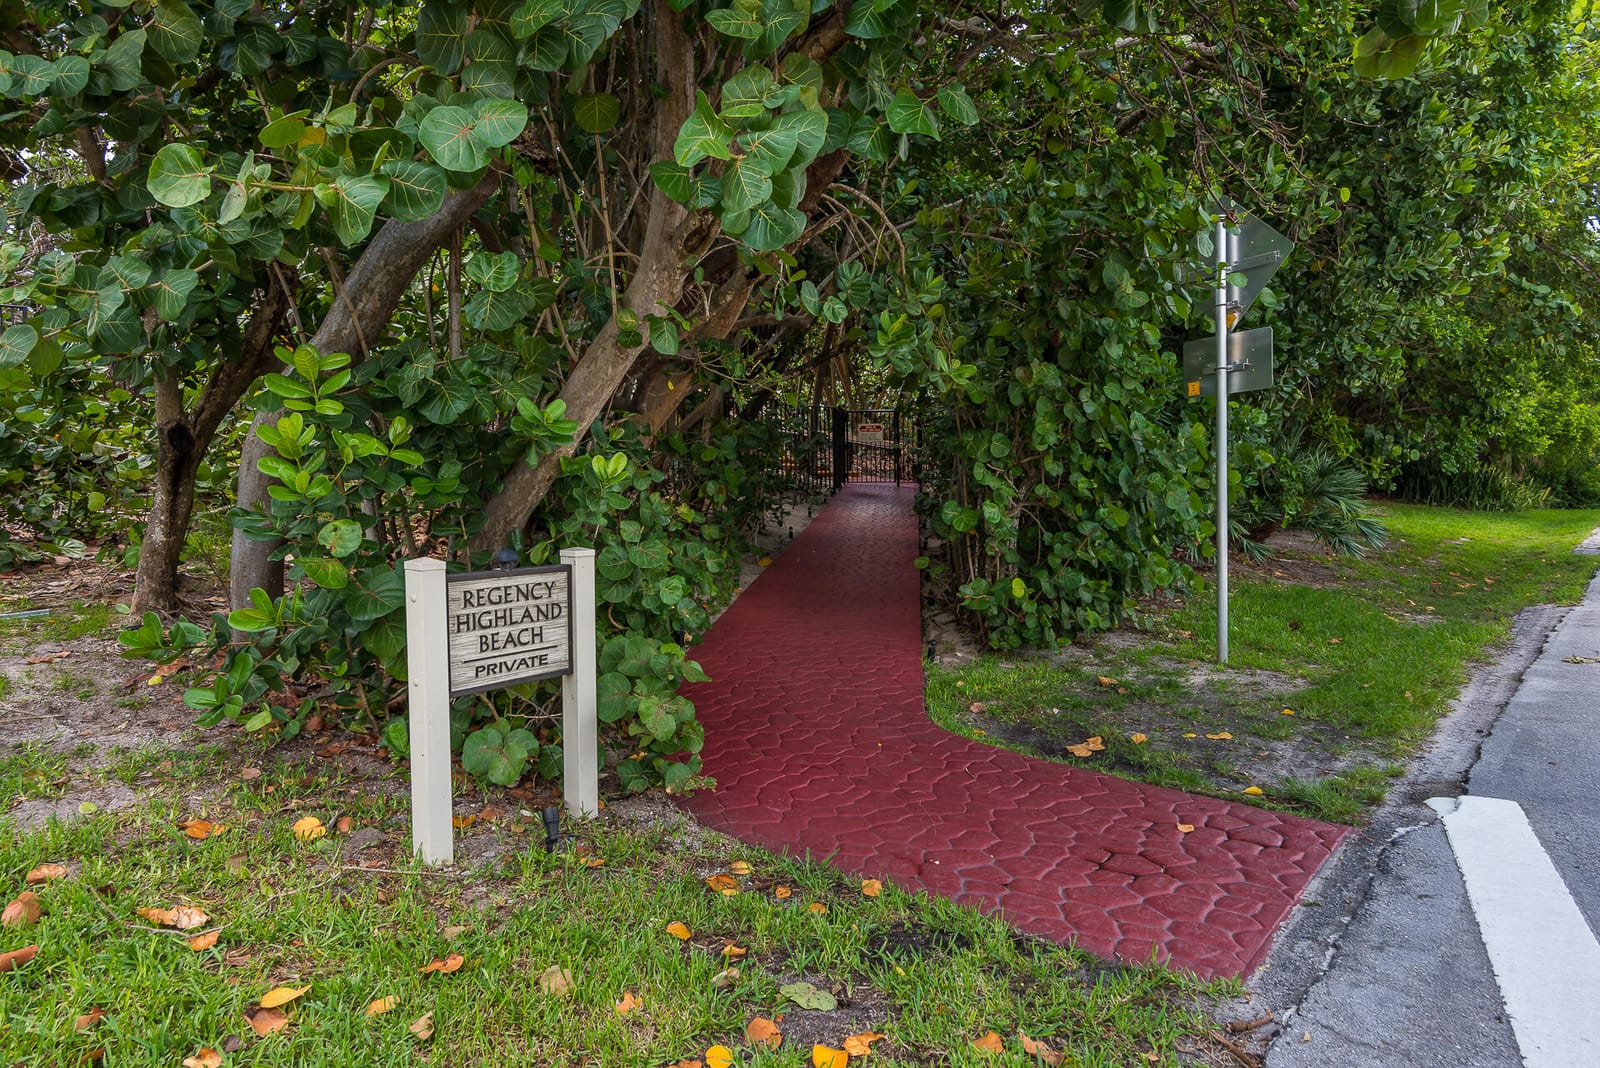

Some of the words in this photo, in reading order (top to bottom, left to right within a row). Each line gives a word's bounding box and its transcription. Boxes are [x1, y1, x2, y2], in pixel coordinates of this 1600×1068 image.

[462, 581, 557, 609] REGENCY
[455, 602, 563, 634] HIGHLAND
[479, 626, 544, 654] BEACH
[474, 653, 549, 679] PRIVATE
